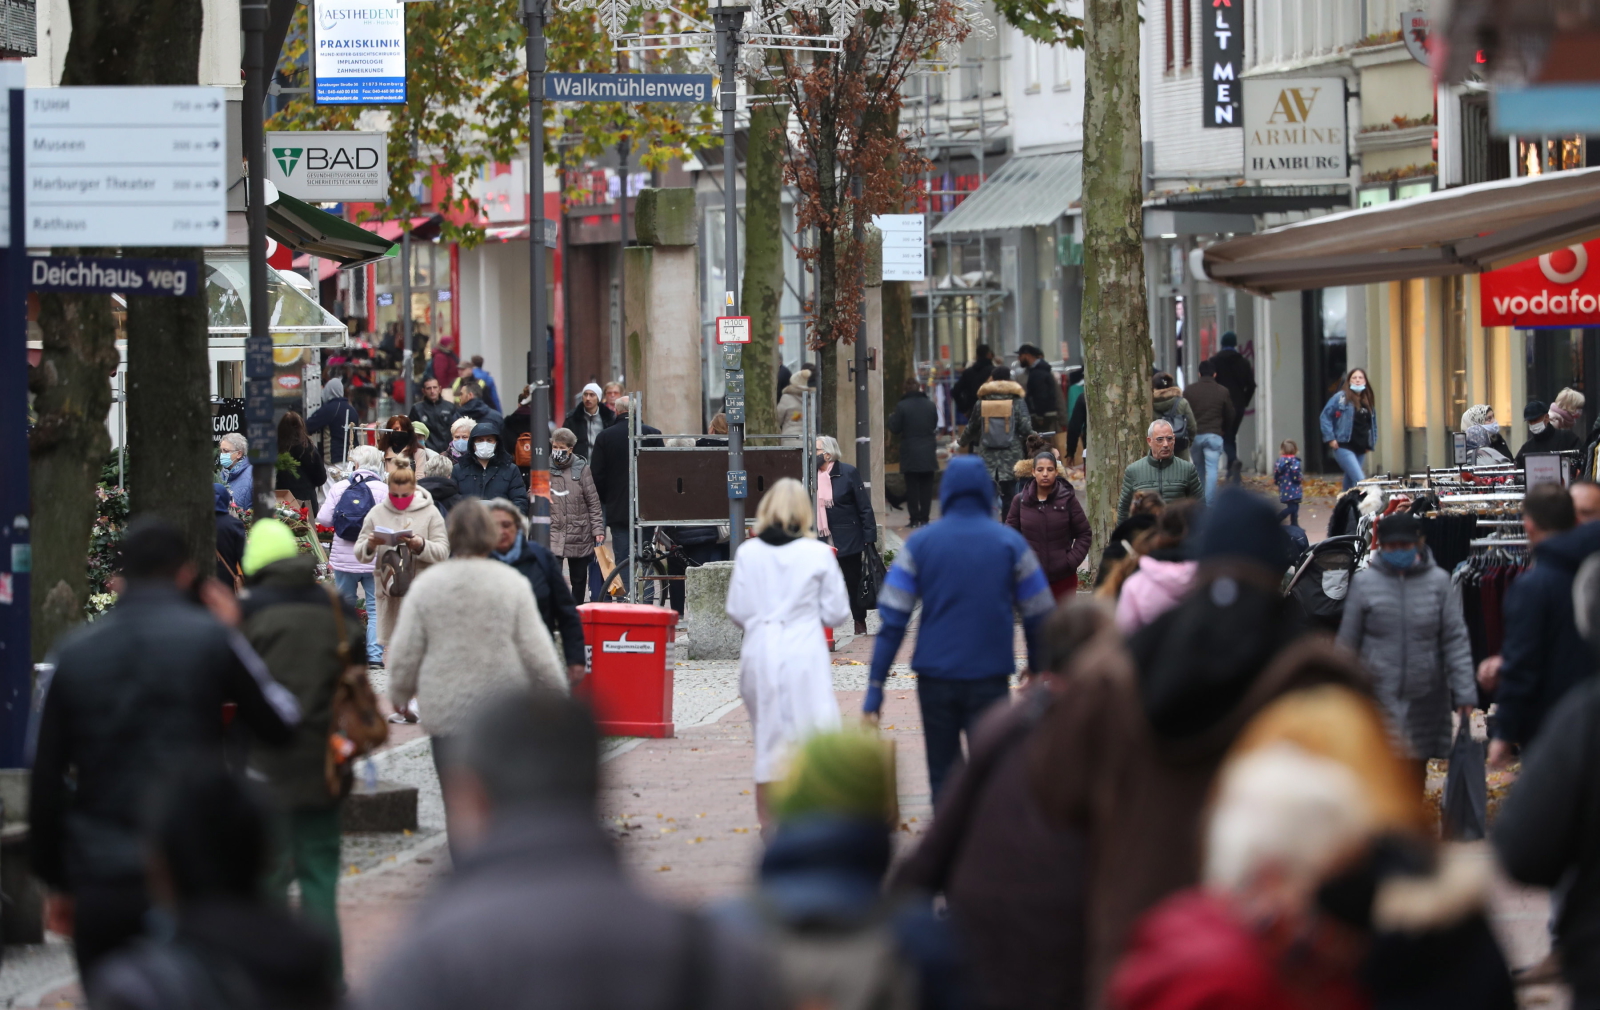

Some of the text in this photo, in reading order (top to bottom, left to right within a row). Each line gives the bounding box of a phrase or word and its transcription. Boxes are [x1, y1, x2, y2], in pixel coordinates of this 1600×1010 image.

[325, 9, 400, 20] AESTHEDENT
[320, 39, 400, 48] PRAXISKLINIK
[554, 78, 704, 100] Walkmühlenweg
[1213, 61, 1234, 124] MEN
[33, 138, 86, 150] Museen
[1252, 156, 1340, 170] HAMBURG
[33, 178, 100, 194] Harburger
[106, 177, 156, 190] Theater
[33, 218, 86, 230] Rathaus
[1492, 288, 1600, 315] vodafo
[212, 414, 239, 432] GROß
